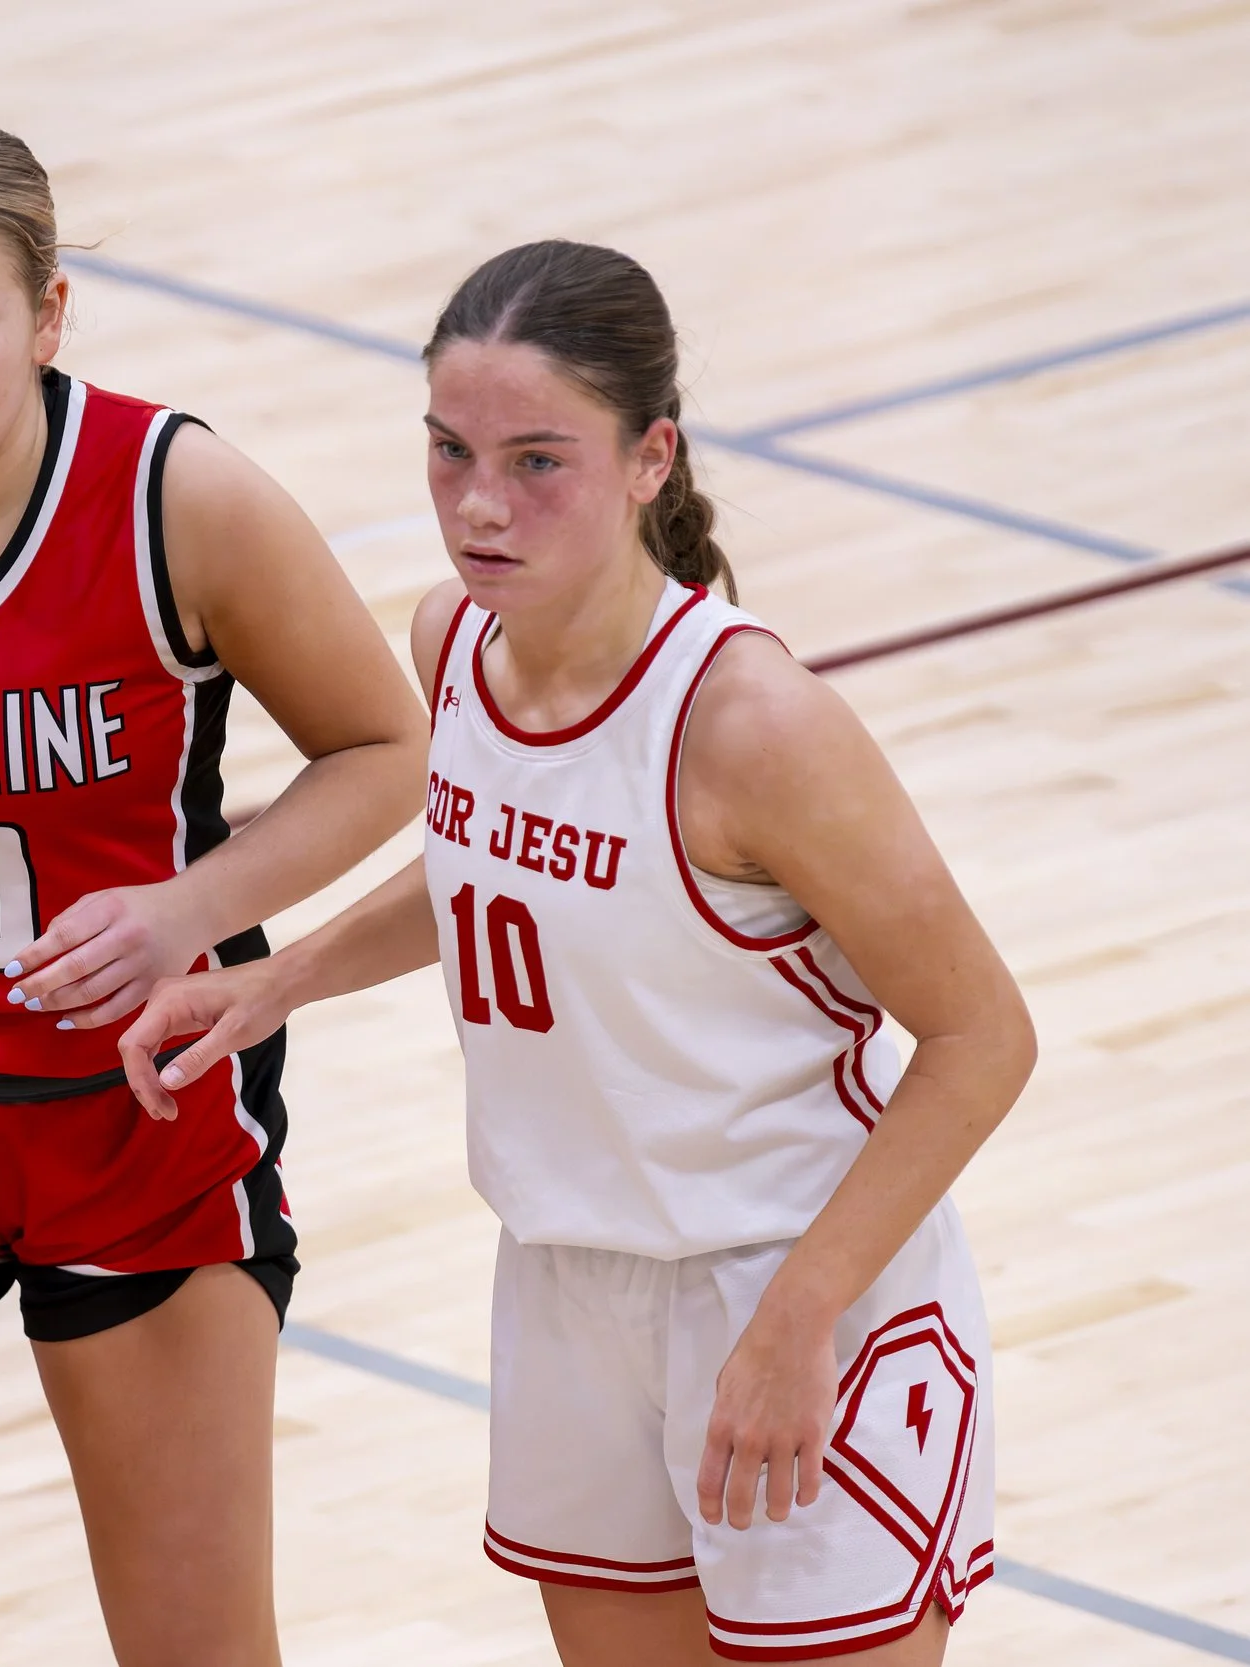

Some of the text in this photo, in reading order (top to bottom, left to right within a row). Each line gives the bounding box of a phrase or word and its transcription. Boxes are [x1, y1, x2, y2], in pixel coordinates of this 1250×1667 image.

[426, 770, 628, 891] COR JESU
[450, 882, 555, 1034] 10
